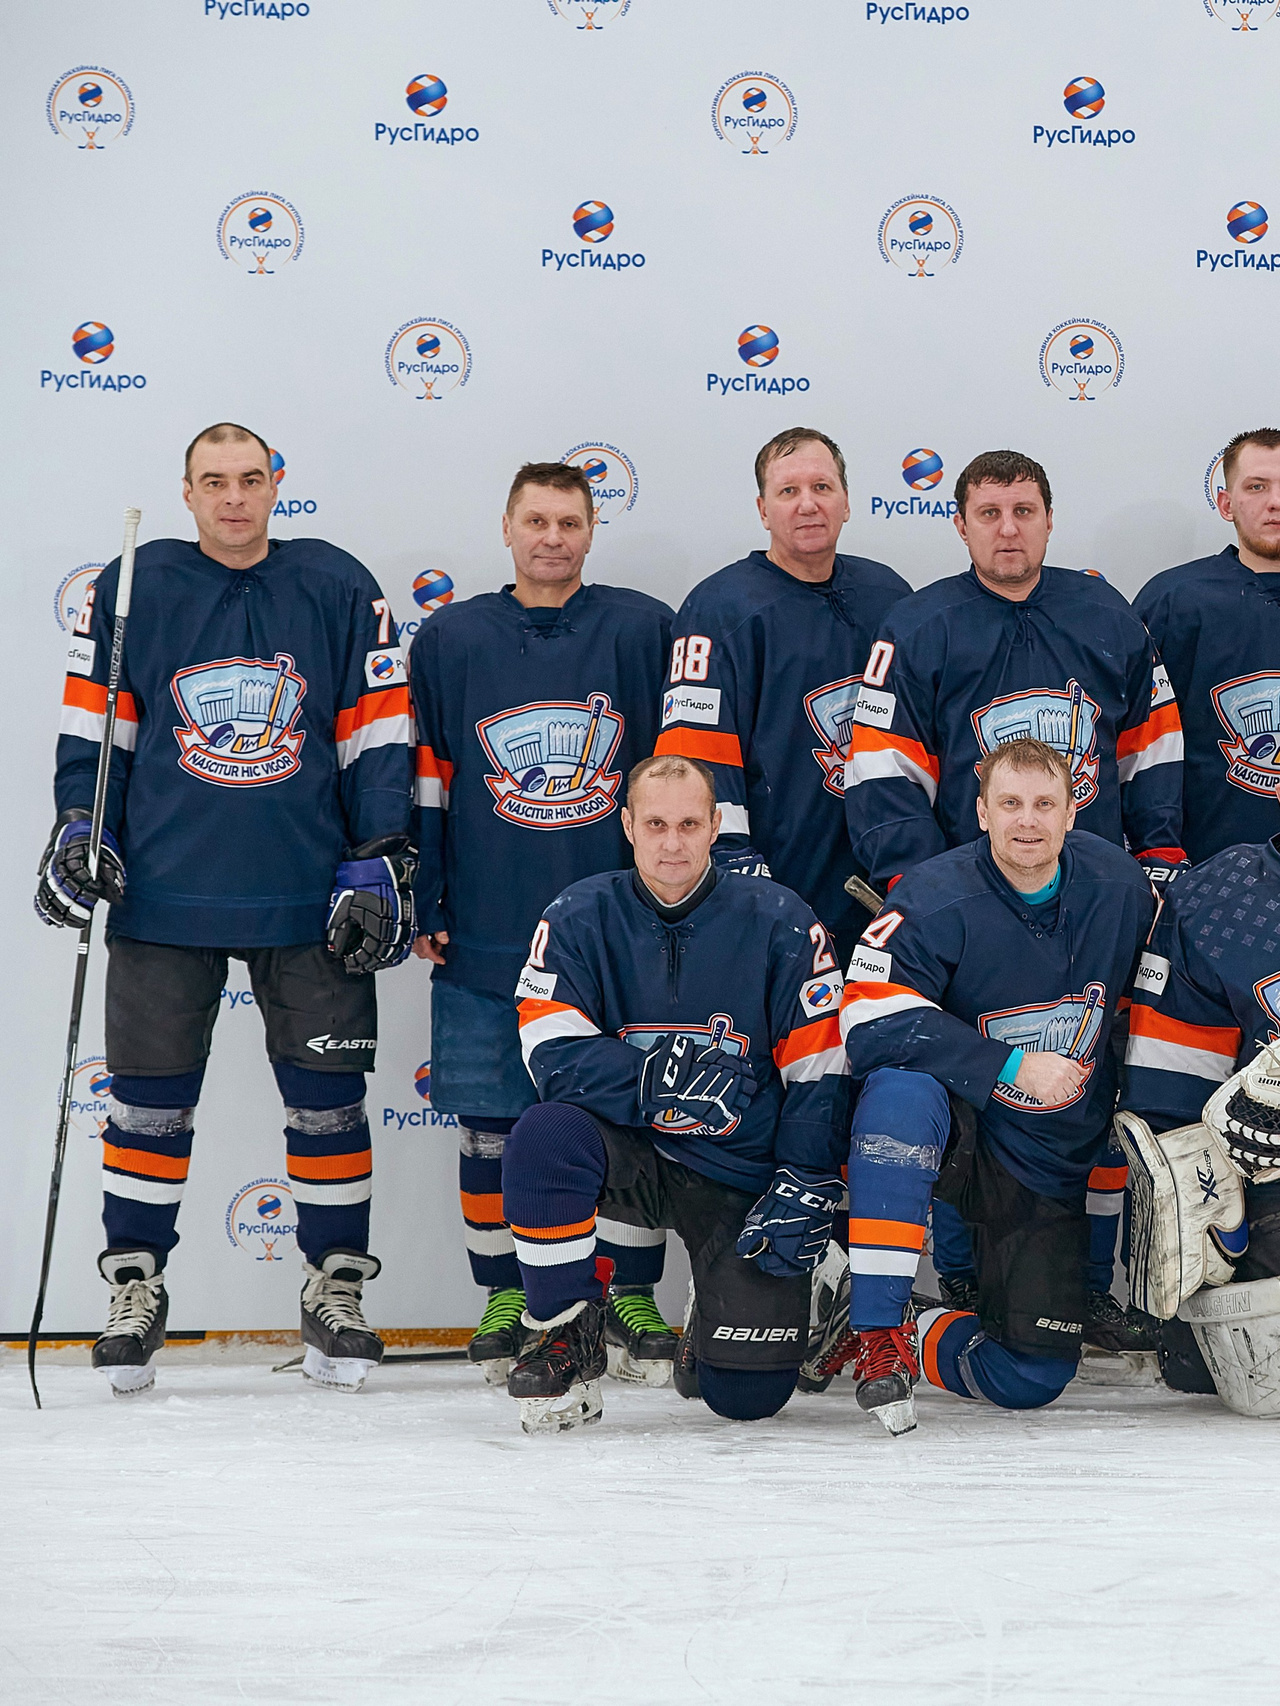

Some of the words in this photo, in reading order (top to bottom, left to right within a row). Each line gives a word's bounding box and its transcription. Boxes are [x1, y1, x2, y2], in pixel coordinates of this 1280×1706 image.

[205, 0, 310, 20] РусГидро
[867, 3, 969, 24] РусГидро
[723, 69, 762, 87] ХОККЕЙНАЯ
[763, 71, 781, 83] ЛИГА
[778, 79, 798, 105] ГРУППЫ
[60, 110, 122, 124] РусГидро
[709, 83, 726, 141] КОРПОРАТИВНАЯ
[725, 116, 785, 129] РусГидро
[375, 123, 479, 145] РусГидро
[784, 105, 799, 142] РУСГИДРО
[1034, 126, 1135, 147] РусГидро
[889, 193, 929, 210] ХОККЕЙНАЯ
[929, 194, 947, 206] ЛИГА
[944, 203, 964, 228] ГРУППЫ
[230, 236, 291, 249] РусГидро
[875, 207, 892, 264] КОРПОРАТИВНАЯ
[891, 239, 951, 252] РусГидро
[950, 229, 965, 265] РУСГИДРО
[542, 249, 645, 271] РусГидро
[1050, 316, 1090, 334] ХОККЕЙНАЯ
[1090, 318, 1108, 330] ЛИГА
[1106, 326, 1125, 352] ГРУППЫ
[398, 362, 459, 374] РусГидро
[1037, 330, 1053, 388] КОРПОРАТИВНАЯ
[1052, 363, 1112, 376] РусГидро
[41, 370, 146, 392] РусГидро
[1111, 352, 1126, 389] РУСГИДРО
[707, 374, 810, 395] РусГидро
[1204, 456, 1218, 510] КОРПОРАТИВНАЯ
[872, 497, 958, 518] РусГидр
[371, 598, 390, 645] 7
[67, 649, 92, 661] сГидро
[670, 635, 713, 683] 88
[857, 699, 889, 715] сГидро
[188, 752, 239, 777] NASCITUR
[241, 765, 261, 777] HIC
[262, 755, 294, 775] VIGOR
[1073, 782, 1093, 800] GOR
[504, 799, 553, 820] NASCITUR
[555, 807, 574, 819] HIC
[574, 796, 608, 816] VIGOR
[851, 958, 885, 974] сГидро
[325, 1039, 377, 1050] EASTO
[662, 1034, 688, 1089] CC
[71, 1101, 106, 1113] РусГи
[383, 1108, 458, 1130] РусГид
[775, 1182, 838, 1213] CCM
